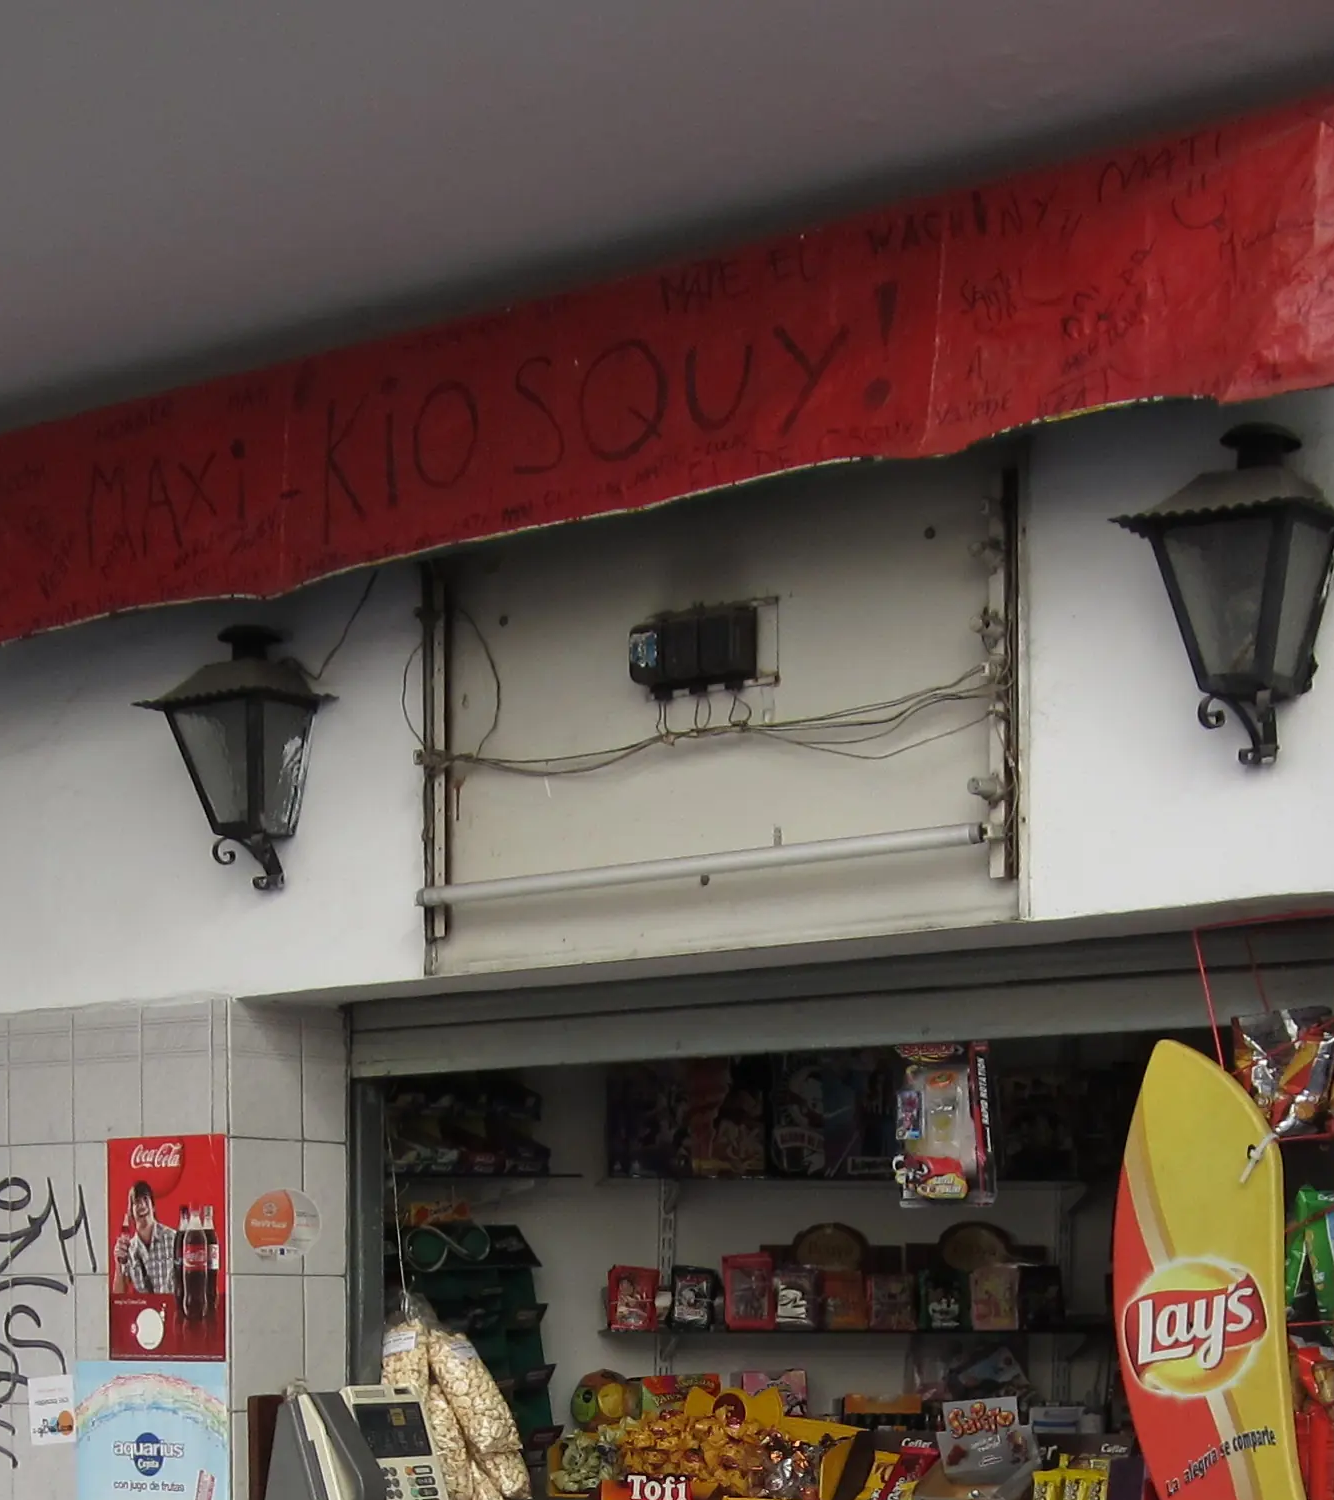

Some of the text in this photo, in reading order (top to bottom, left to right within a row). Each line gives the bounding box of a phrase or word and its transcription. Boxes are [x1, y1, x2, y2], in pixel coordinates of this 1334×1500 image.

[1136, 1279, 1257, 1370] Lay's
[113, 1439, 185, 1460] aquarius
[1219, 1440, 1231, 1458] se
[1232, 1426, 1276, 1453] comparte
